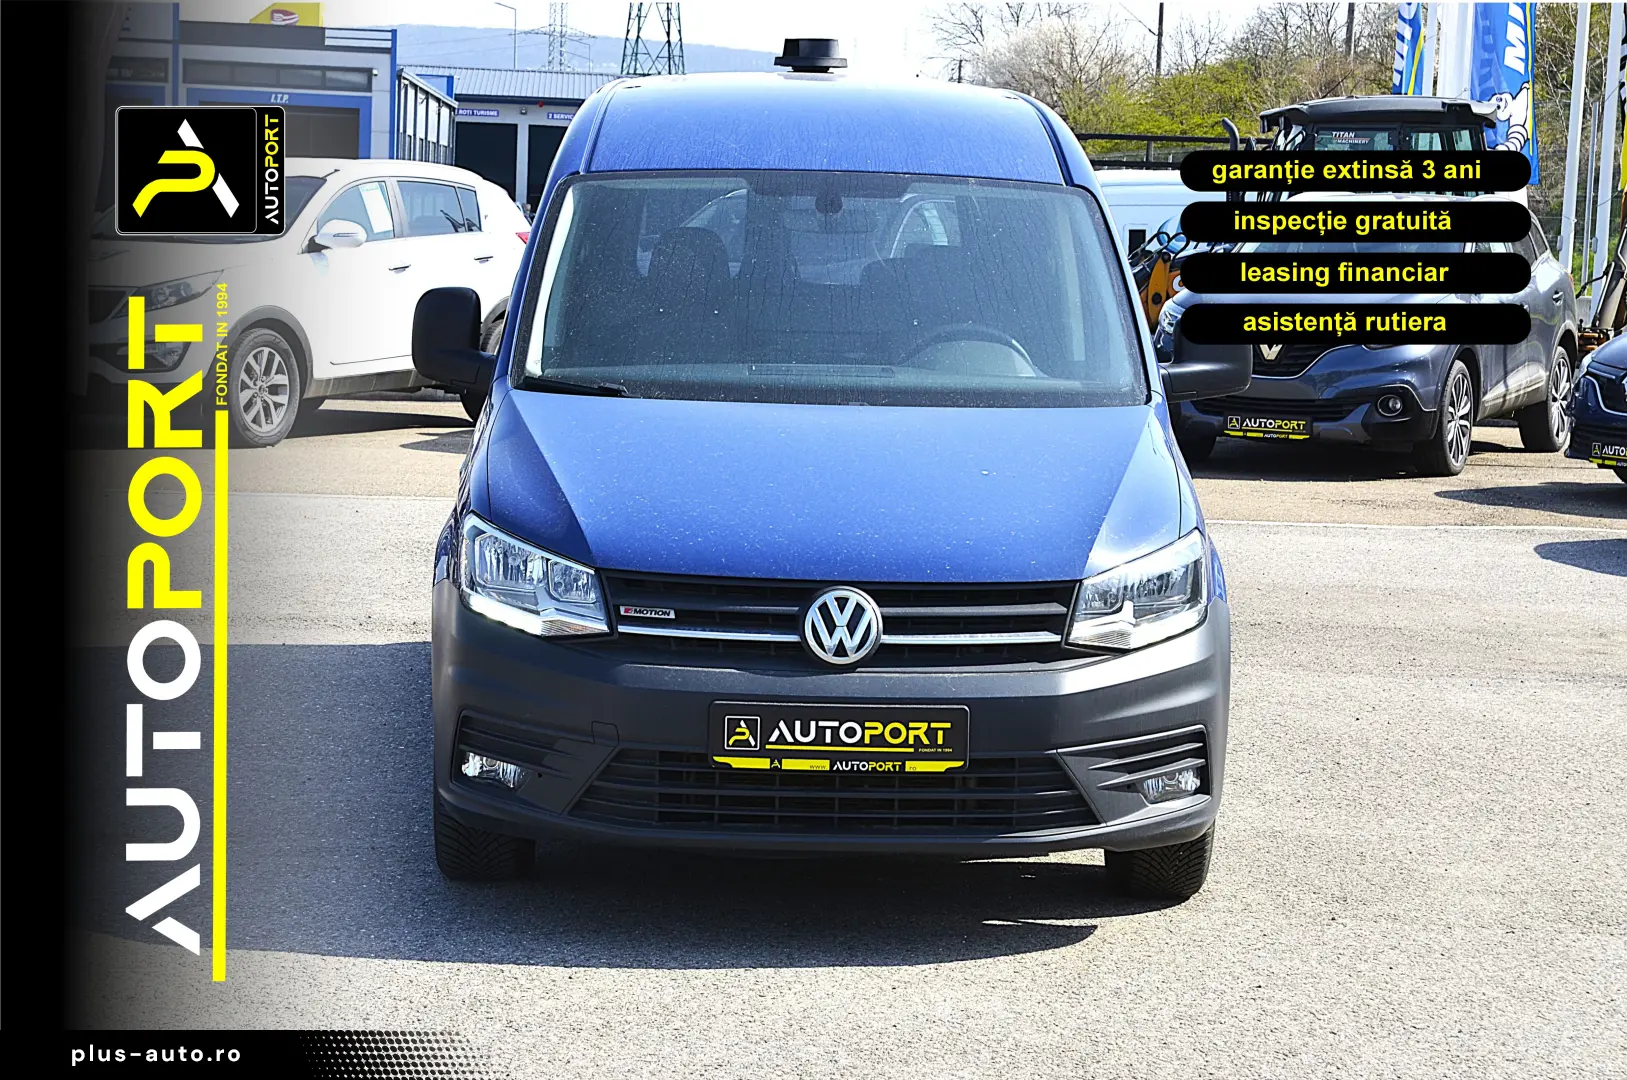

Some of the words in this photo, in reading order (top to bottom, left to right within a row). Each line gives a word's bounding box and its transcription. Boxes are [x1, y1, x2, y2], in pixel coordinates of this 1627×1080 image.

[1242, 417, 1306, 430] AUTOPORT
[1602, 445, 1627, 457] AUTO
[769, 719, 952, 745] AUTOPORT
[832, 761, 902, 772] AUTOPORT
